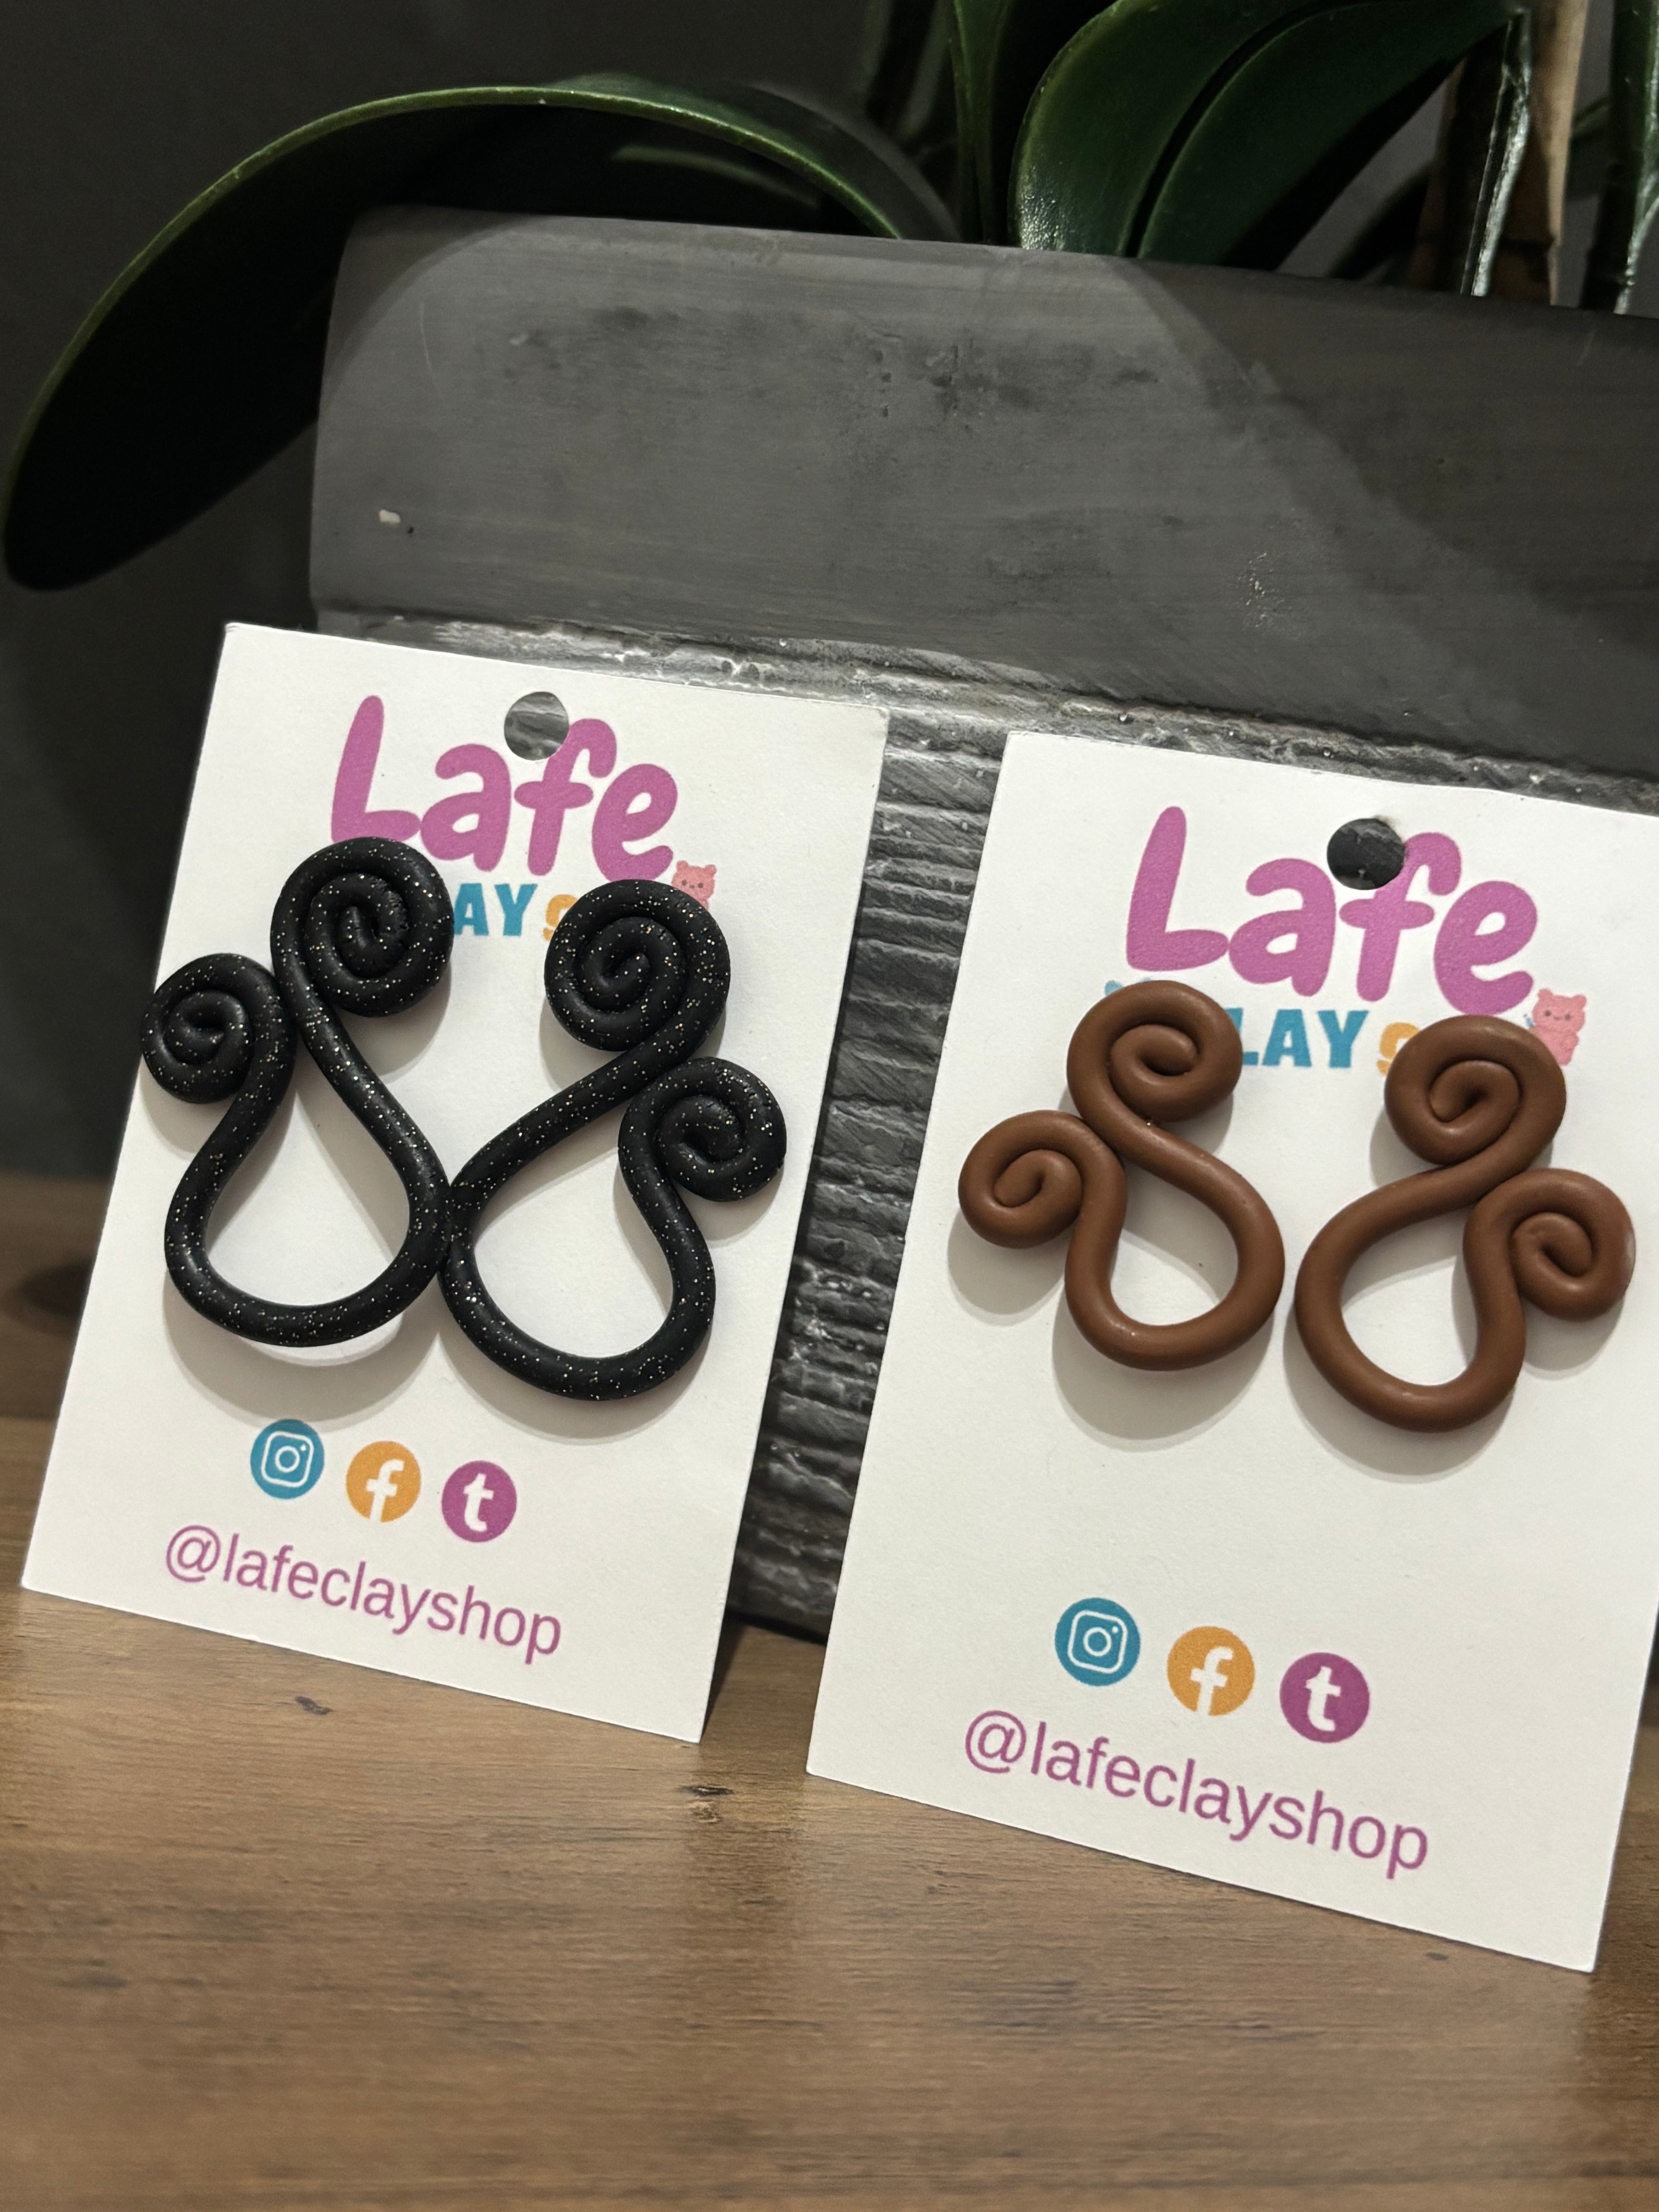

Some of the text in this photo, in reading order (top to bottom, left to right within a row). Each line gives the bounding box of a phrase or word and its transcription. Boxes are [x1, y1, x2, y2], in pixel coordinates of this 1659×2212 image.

[331, 696, 677, 884] Lafe
[1126, 807, 1537, 1015] Lafe
[165, 1525, 561, 1665] @lafeclayshop
[964, 1710, 1428, 1880] @lafeclayshop
